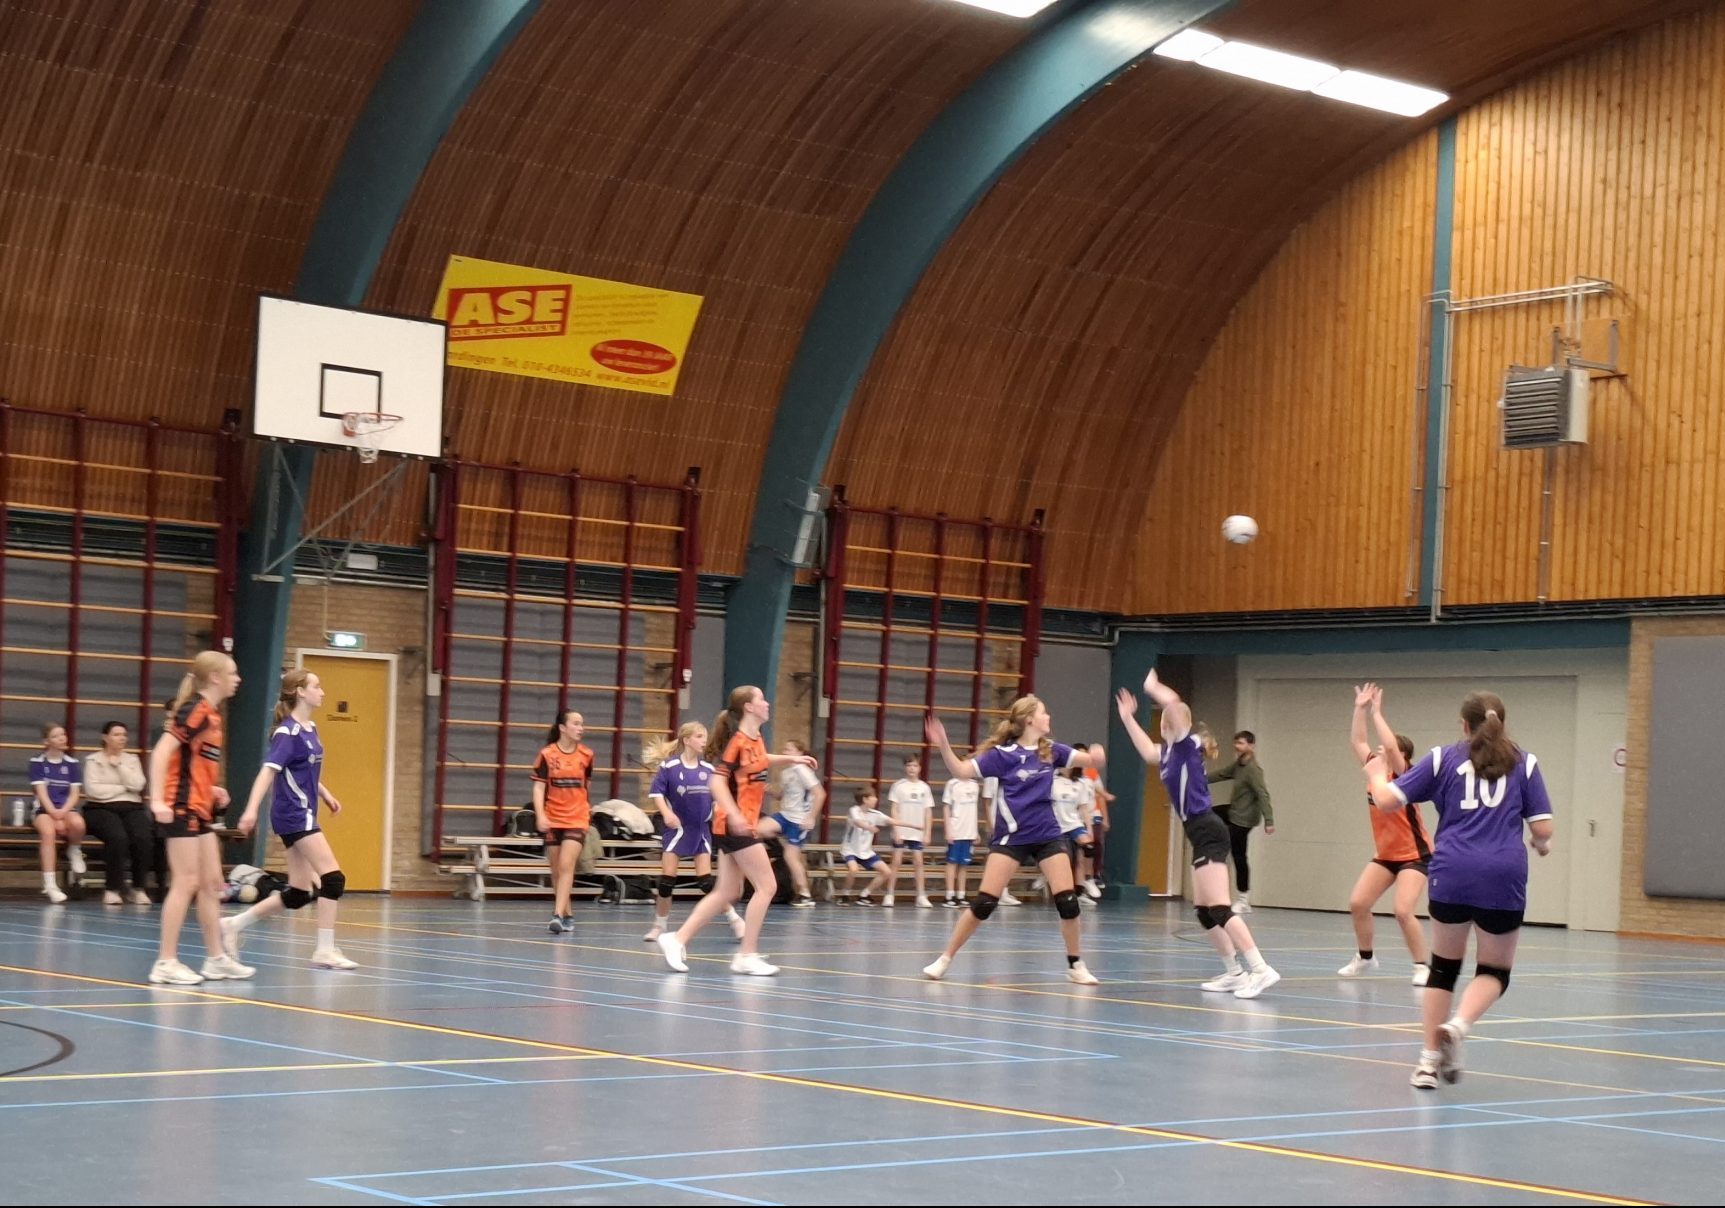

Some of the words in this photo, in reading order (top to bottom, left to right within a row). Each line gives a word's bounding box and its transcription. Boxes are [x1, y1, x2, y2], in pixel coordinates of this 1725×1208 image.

[451, 290, 566, 325] ASE
[476, 324, 557, 335] SPECIALIST
[1456, 759, 1507, 809] 10
